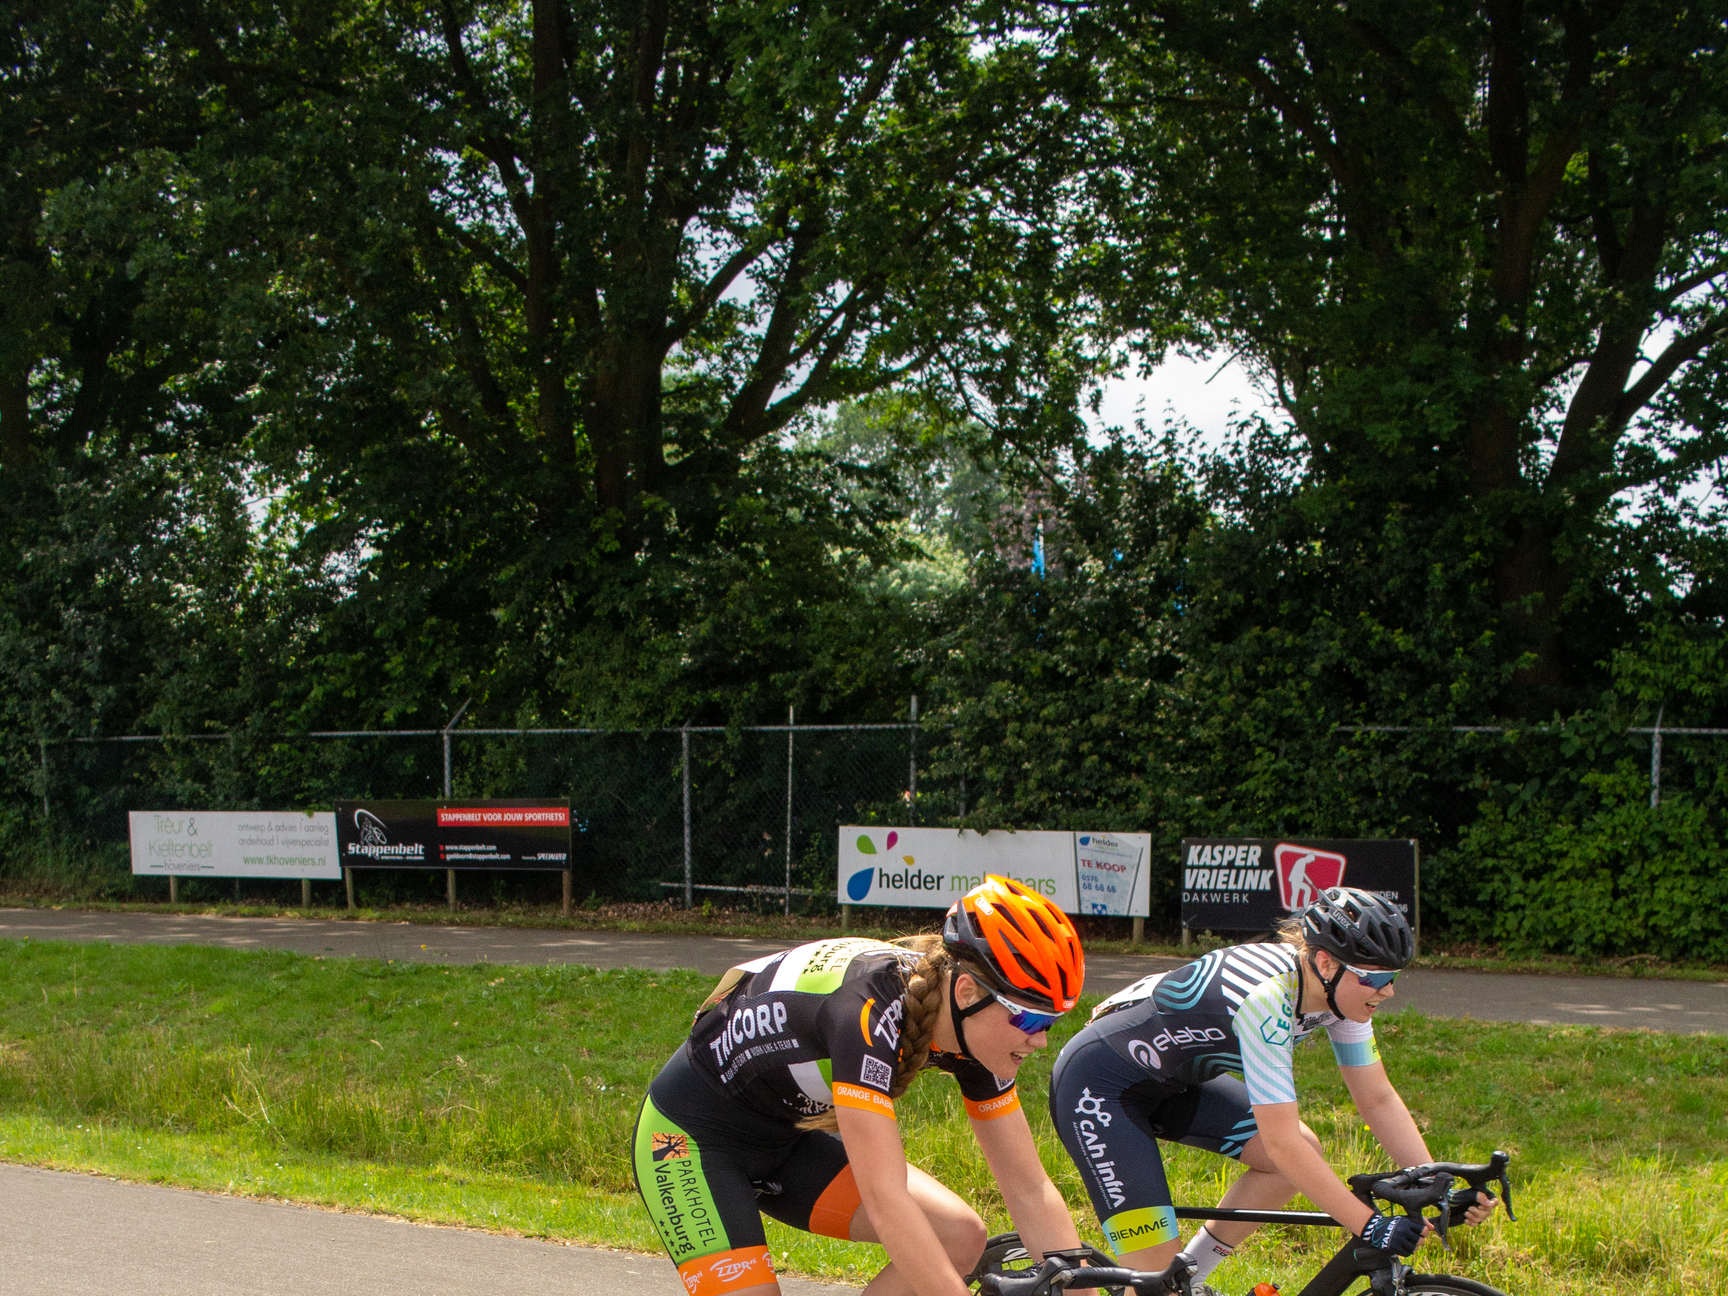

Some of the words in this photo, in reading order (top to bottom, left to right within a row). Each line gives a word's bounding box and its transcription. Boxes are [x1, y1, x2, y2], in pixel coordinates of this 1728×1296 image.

[187, 817, 199, 836] &
[441, 813, 481, 822] STAPPENBELT
[483, 813, 502, 821] VOOR
[504, 813, 523, 821] JOUW
[524, 812, 565, 821] SPORTFIETS!
[348, 842, 425, 858] Stappenbelt
[1092, 836, 1119, 848] helder
[1187, 845, 1262, 866] KASPER
[1081, 859, 1093, 869] TE
[1095, 861, 1127, 873] KOOP
[879, 867, 944, 891] helder
[1082, 882, 1093, 890] 68
[1095, 883, 1105, 891] 68
[1107, 885, 1117, 893] 68
[1185, 869, 1274, 890] VRIELINK
[1183, 892, 1249, 903] DAKWERK
[1332, 910, 1352, 929] uvex
[709, 1001, 788, 1067] TRICORP
[1153, 1026, 1227, 1052] elabo
[837, 1086, 871, 1101] ORANGE
[653, 1162, 696, 1254] Valkenburg
[676, 1160, 717, 1247] PARKHOTEL
[1108, 1217, 1169, 1242] BIEMME
